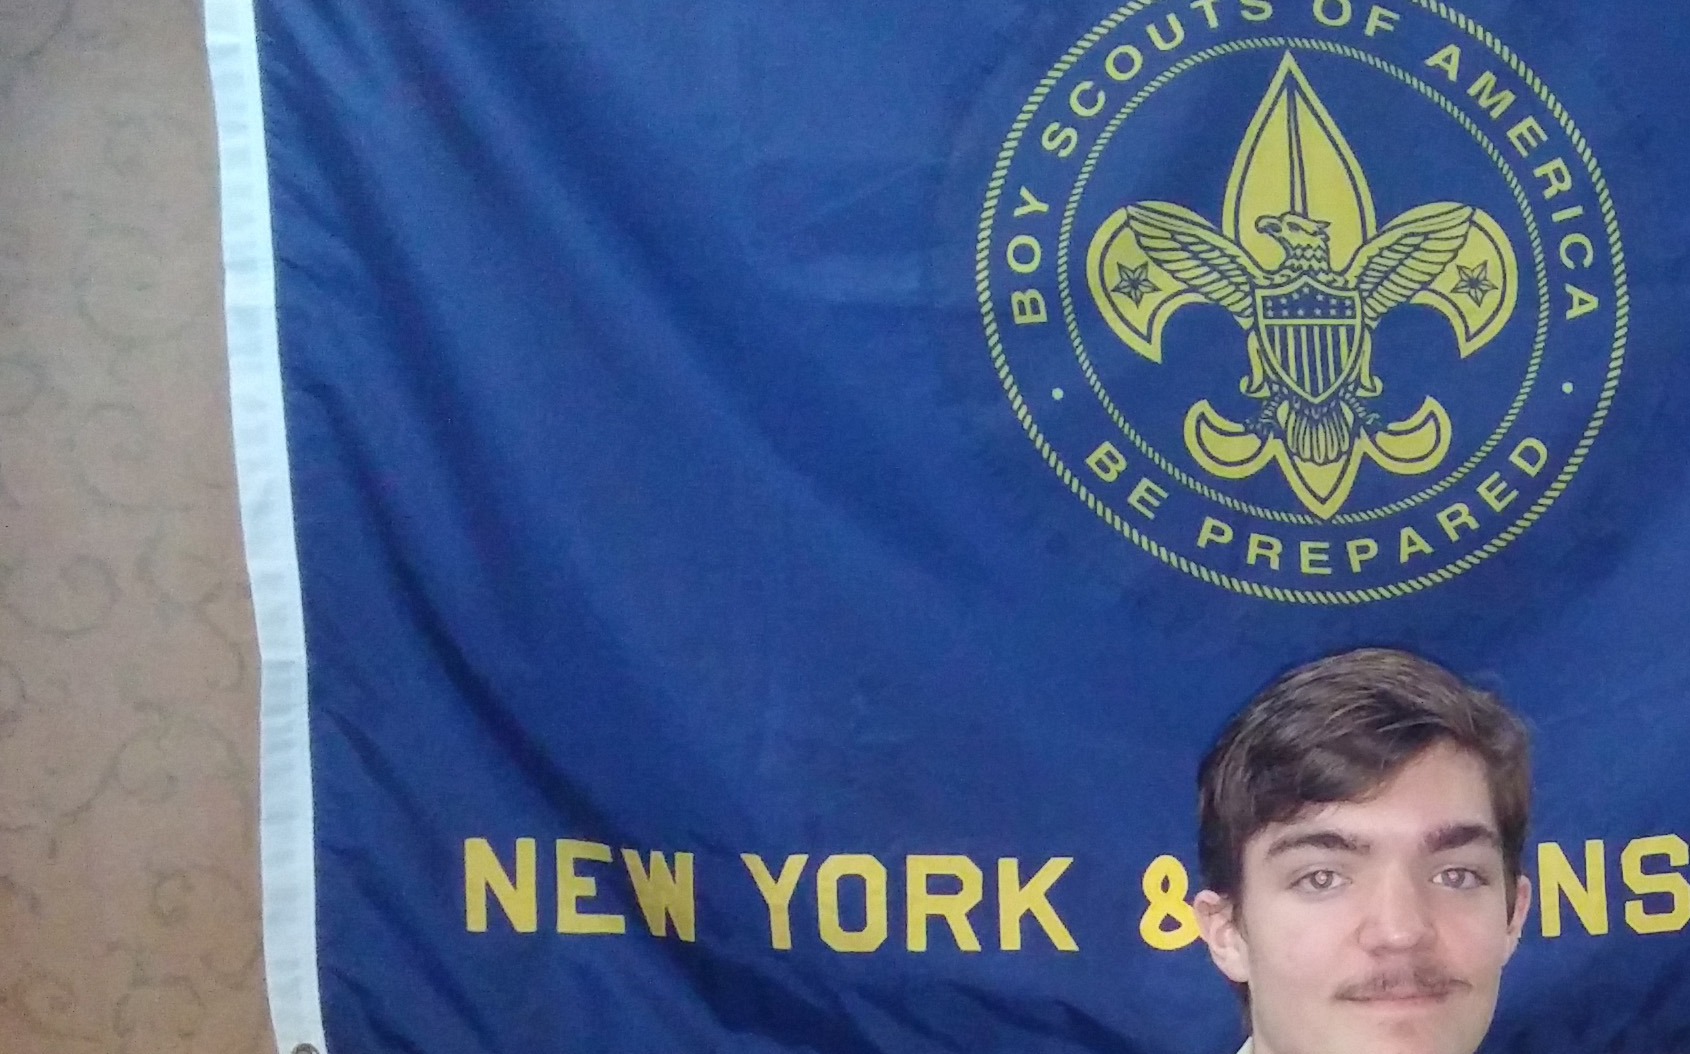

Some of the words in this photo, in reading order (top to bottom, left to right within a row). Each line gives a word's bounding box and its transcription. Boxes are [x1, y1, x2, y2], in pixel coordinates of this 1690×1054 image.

[1006, 185, 1050, 325] BOY
[1042, 0, 1274, 158] SCOUTS
[1312, 0, 1400, 38] OF
[1425, 42, 1598, 322] AMERICA
[1086, 440, 1169, 520] BE
[1197, 436, 1549, 575] PREPARED
[463, 836, 696, 943] NEW
[741, 853, 1080, 953] YORK
[1139, 854, 1201, 951] &
